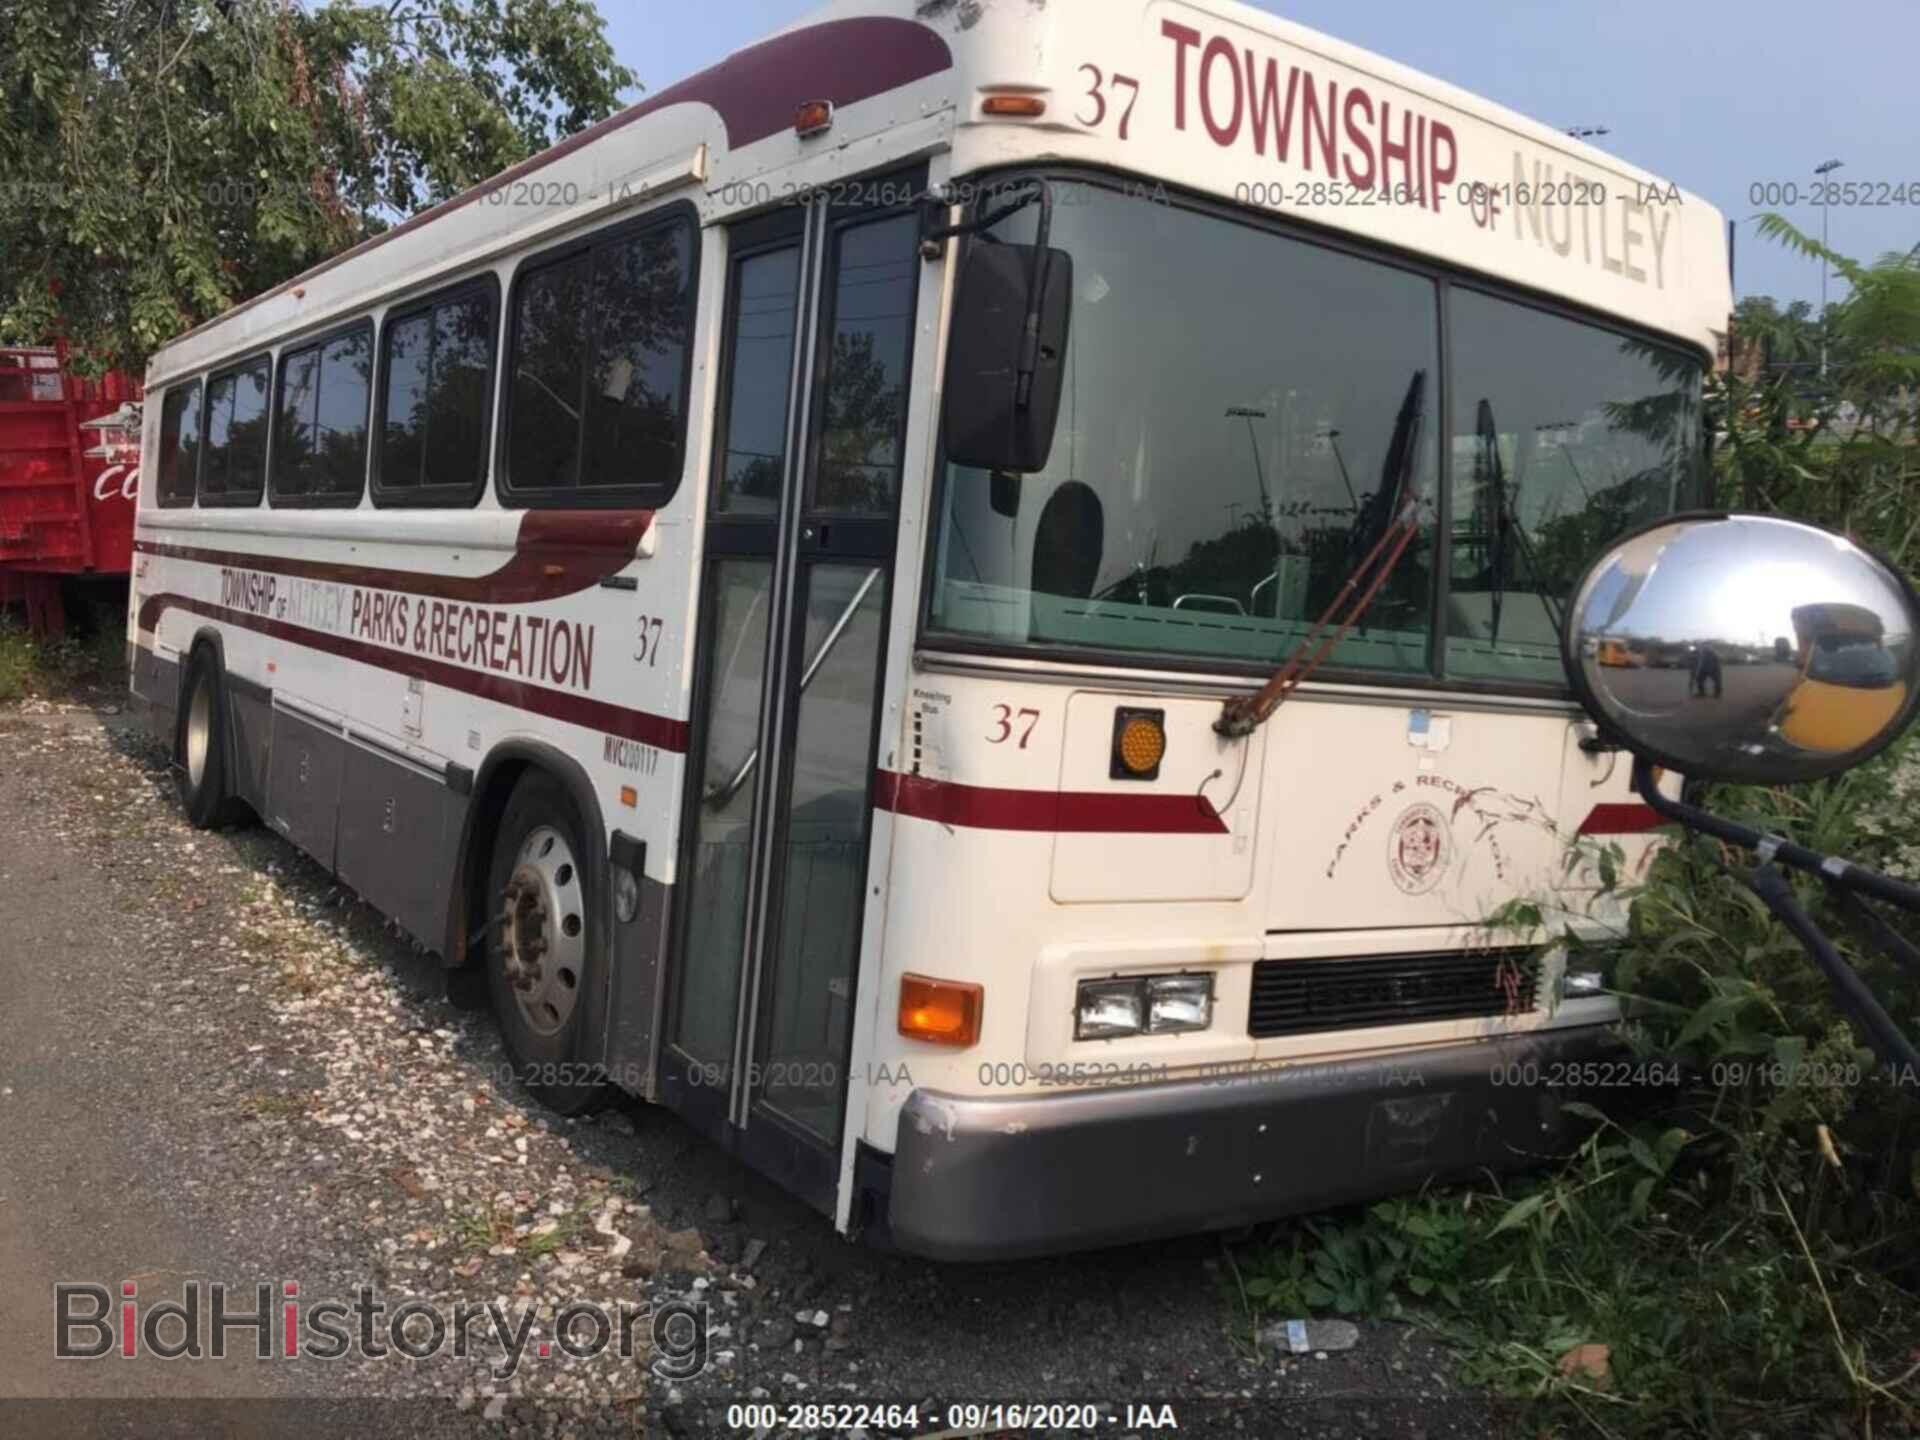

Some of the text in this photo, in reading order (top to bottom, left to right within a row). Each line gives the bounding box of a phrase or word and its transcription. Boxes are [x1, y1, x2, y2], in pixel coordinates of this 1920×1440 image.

[1074, 63, 1139, 140] 37
[1161, 18, 1670, 290] TOWNSHIP OF NUTLEY
[221, 567, 276, 615] TOWNSHIP
[351, 589, 408, 646] PARKS
[414, 599, 426, 651] &
[430, 602, 594, 690] RECREATION
[633, 614, 663, 667] 37
[984, 703, 1040, 749] 37
